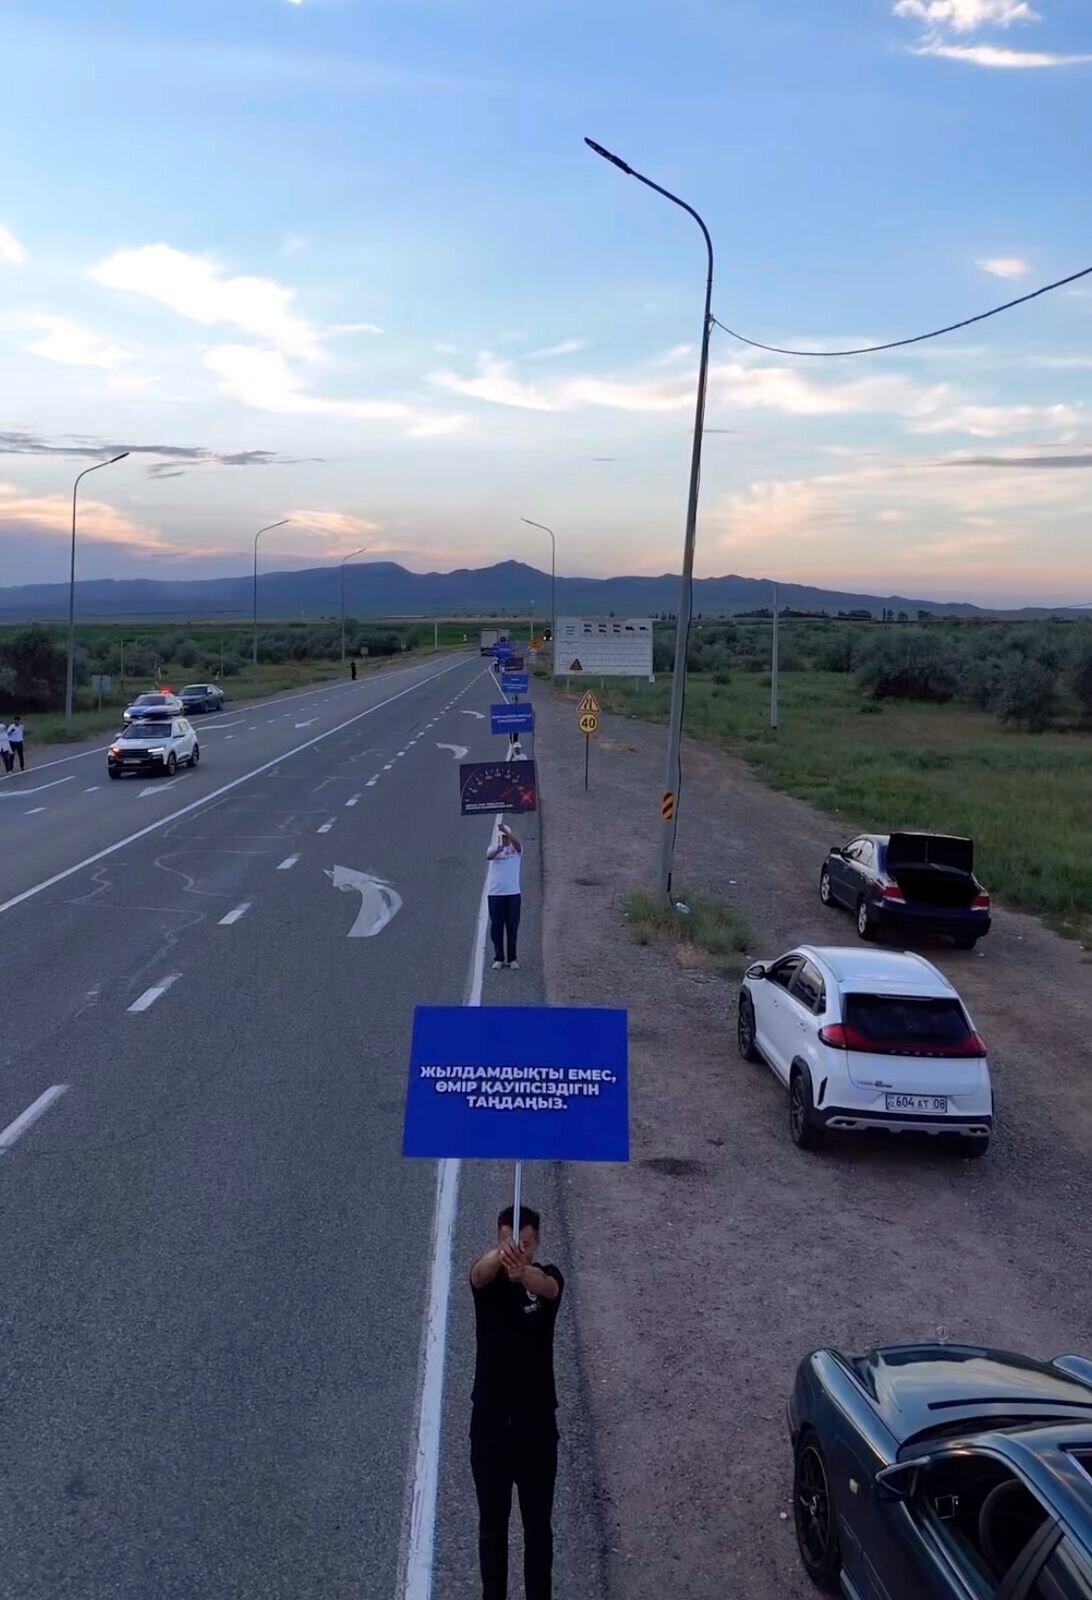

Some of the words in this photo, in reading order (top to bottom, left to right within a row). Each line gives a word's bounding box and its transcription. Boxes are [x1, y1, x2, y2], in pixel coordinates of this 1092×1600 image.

[581, 717, 596, 729] 40
[420, 1066, 564, 1081] ЖЫЛДАМДЫҚТЫ
[568, 1068, 617, 1083] ЕМЕС,
[435, 1081, 478, 1093] ӨМІР
[481, 1082, 600, 1097] ҚАУІПСІЗДІГІН
[467, 1095, 568, 1111] ТАҢДАҢЫЗ.
[895, 1096, 914, 1108] 604
[933, 1098, 946, 1109] 08
